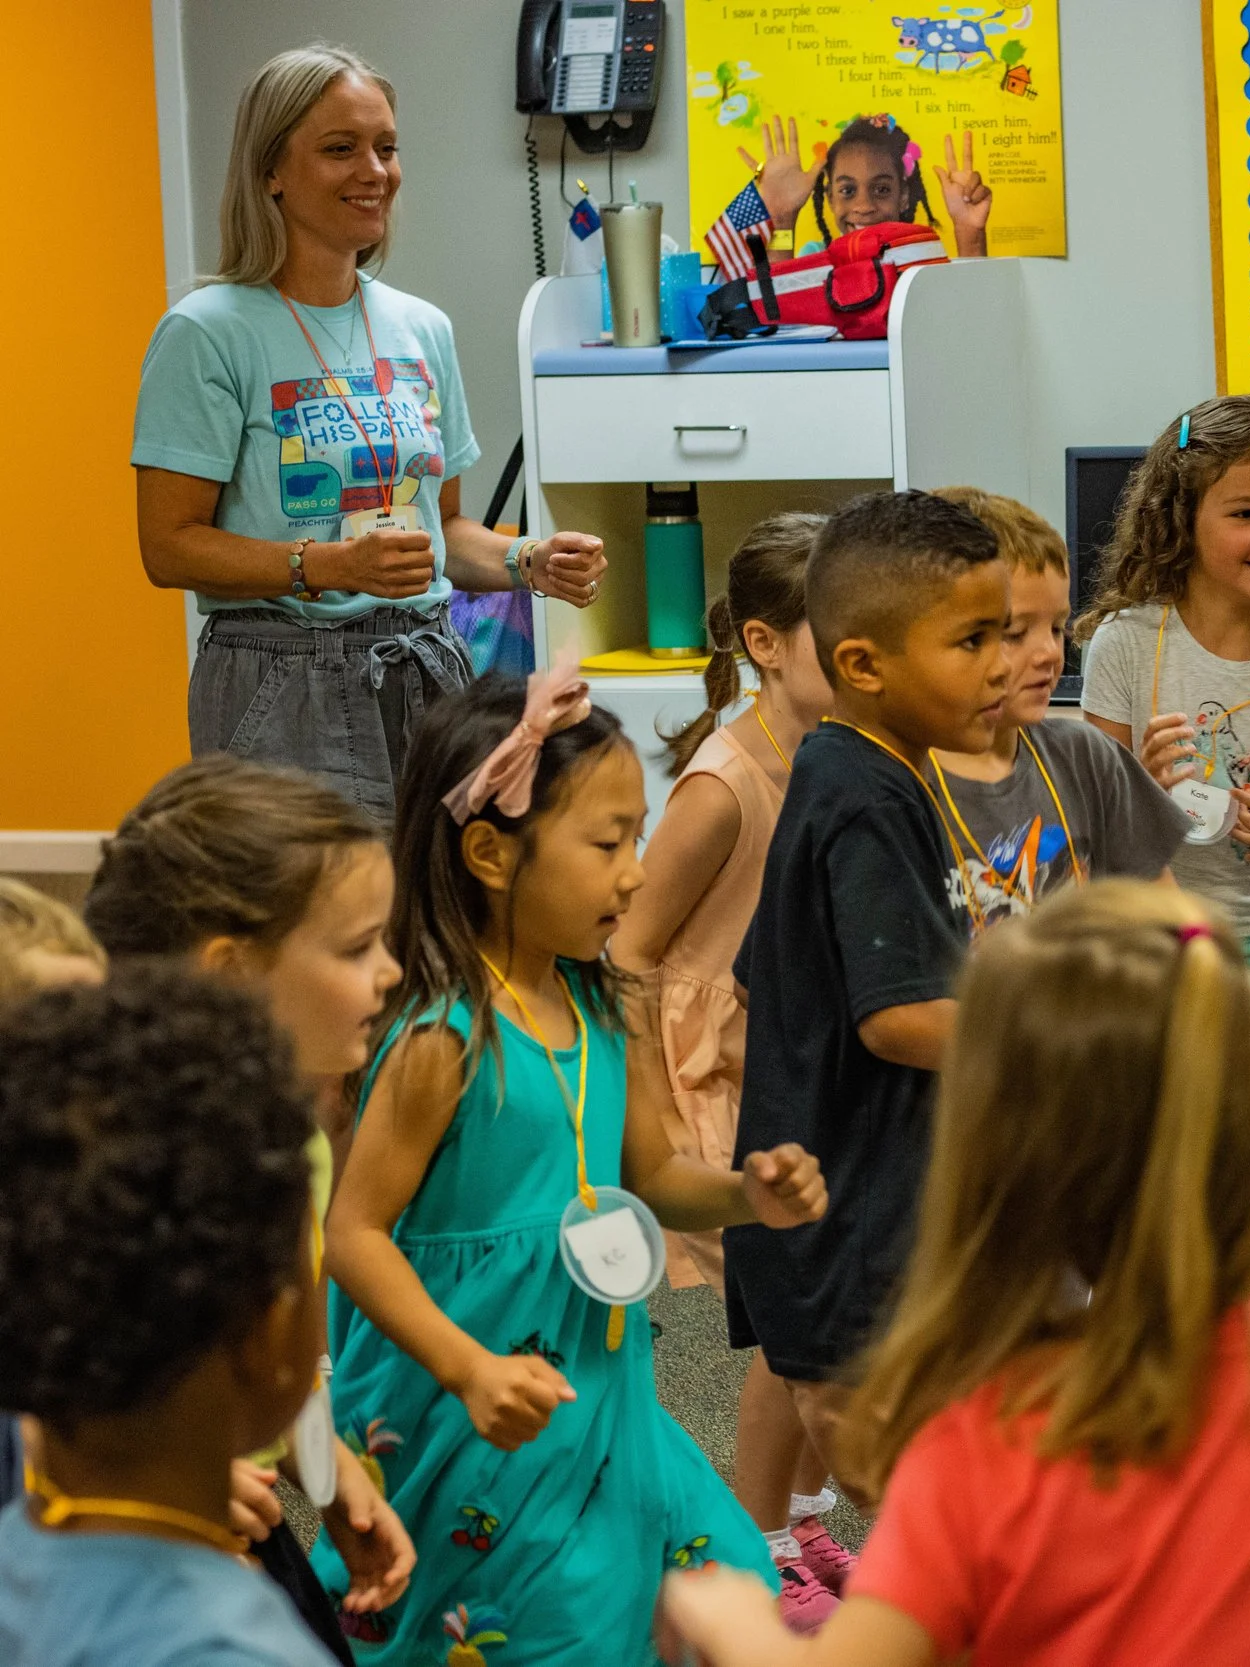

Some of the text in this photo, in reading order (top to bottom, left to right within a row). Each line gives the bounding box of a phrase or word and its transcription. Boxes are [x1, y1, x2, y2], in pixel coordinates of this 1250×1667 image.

[722, 6, 727, 19] I
[733, 9, 754, 19] saw
[760, 8, 768, 17] a
[773, 4, 811, 20] purple
[763, 24, 785, 34] one
[797, 40, 820, 49] two
[826, 54, 857, 66] three
[849, 70, 872, 81] four
[881, 84, 903, 97] five
[925, 102, 941, 113] six
[962, 119, 998, 129] seven
[992, 133, 1023, 148] eight
[321, 367, 353, 376] PALMS
[302, 400, 419, 427] FOLLOW
[287, 498, 337, 510] PASS GO
[1191, 788, 1209, 801] Kate
